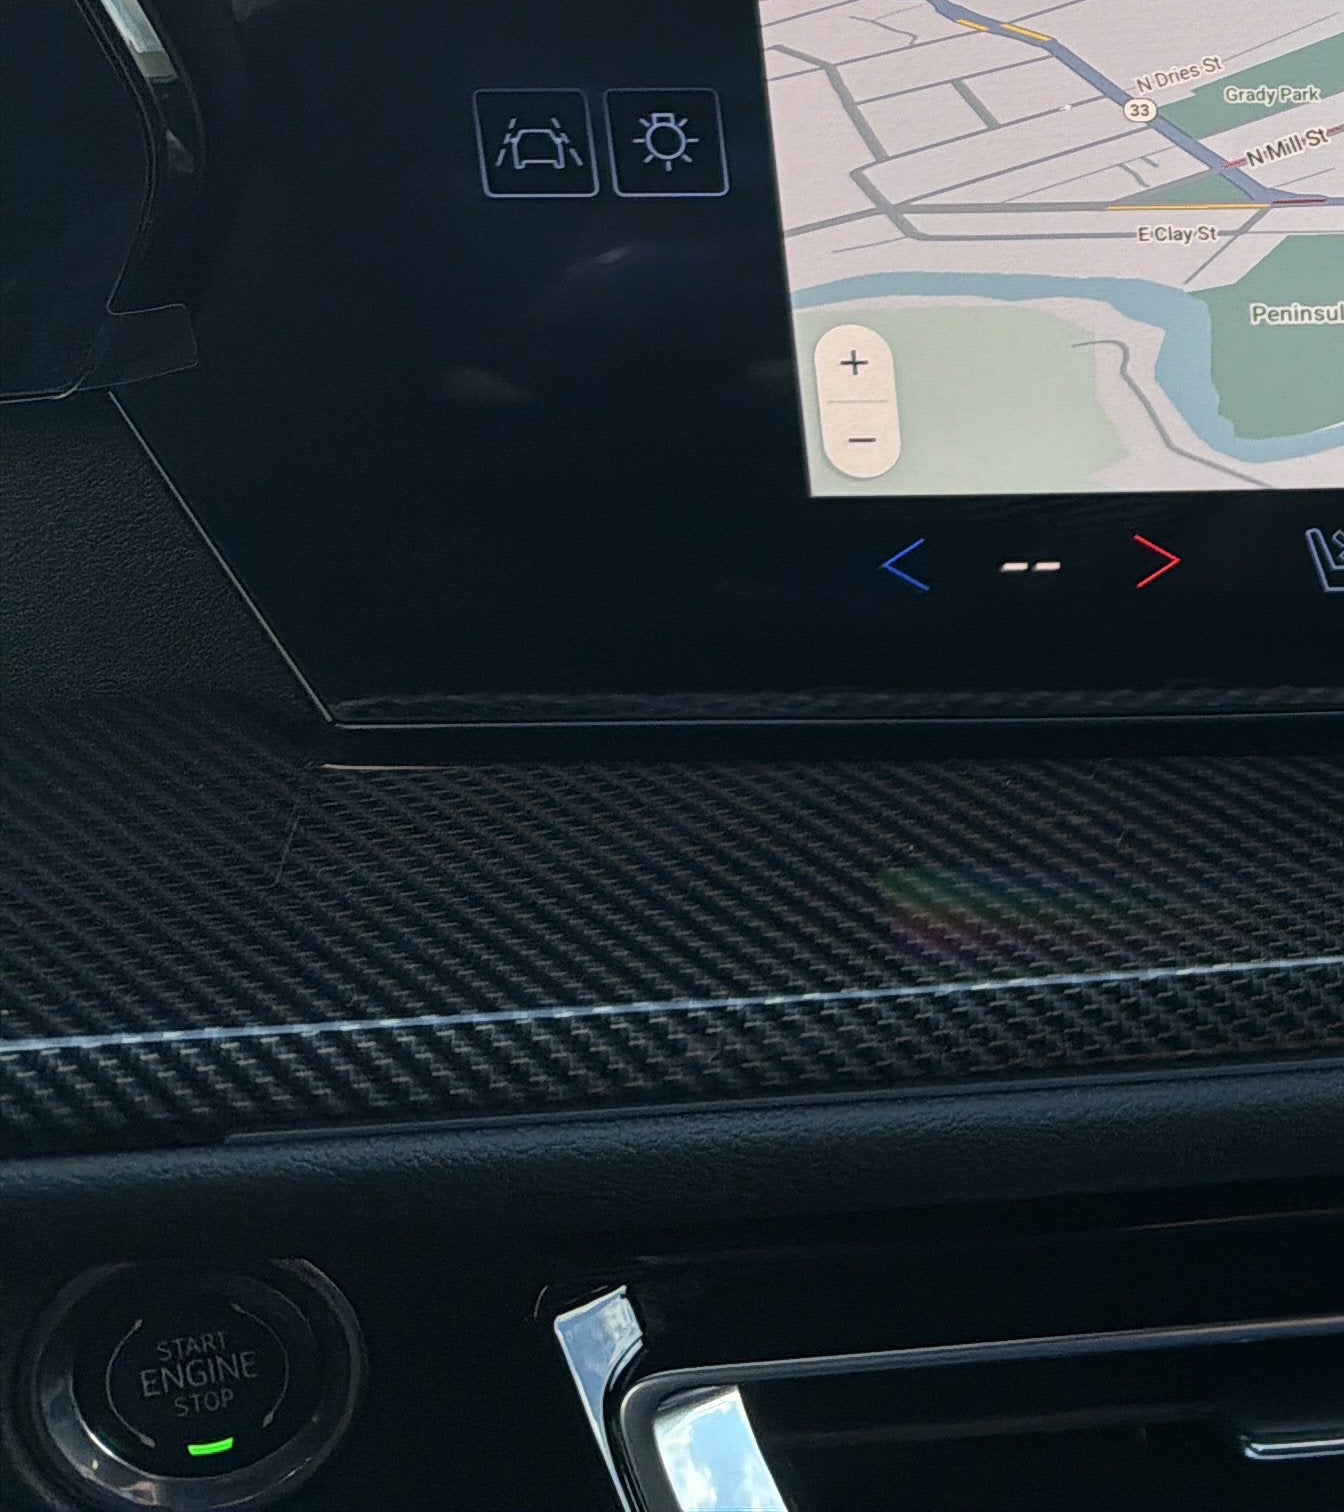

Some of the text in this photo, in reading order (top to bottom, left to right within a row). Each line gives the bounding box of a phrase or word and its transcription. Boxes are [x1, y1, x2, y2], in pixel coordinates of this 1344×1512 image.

[1136, 57, 1223, 93] N Dries St
[1130, 103, 1150, 117] 33
[1225, 87, 1320, 105] Grady Park
[1247, 128, 1328, 168] N Mill St
[1138, 227, 1217, 245] E Clay St
[156, 1331, 227, 1362] START
[139, 1351, 259, 1399] ENGINE
[173, 1388, 234, 1418] STOP
